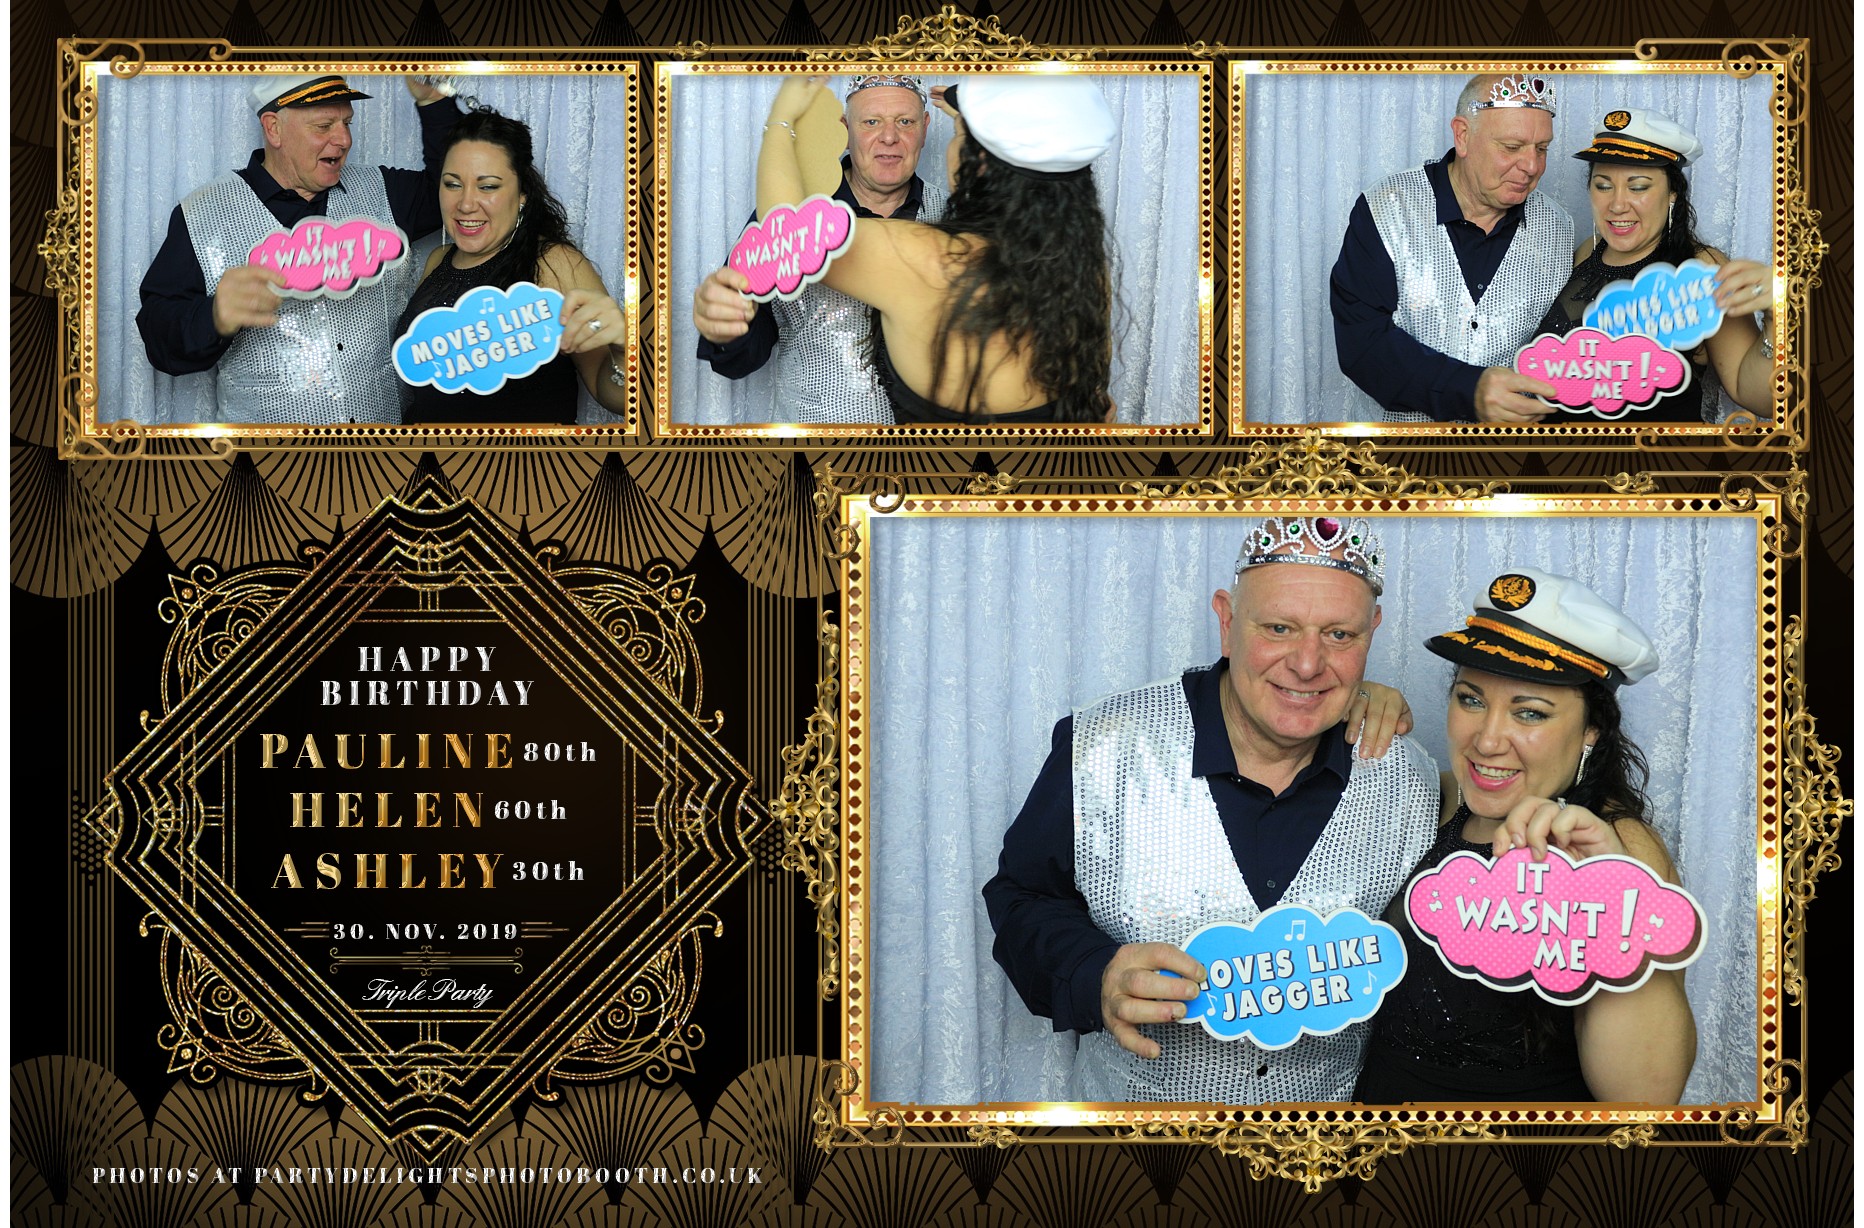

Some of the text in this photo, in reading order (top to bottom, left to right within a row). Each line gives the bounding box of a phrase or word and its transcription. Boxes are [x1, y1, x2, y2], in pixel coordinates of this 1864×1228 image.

[305, 225, 325, 246] IT
[770, 214, 785, 238] IT
[274, 238, 356, 270] WASN'T
[745, 226, 809, 270] WASN'T
[322, 259, 352, 283] ME
[777, 253, 800, 280] ME
[1598, 275, 1715, 331] MOVES LIKE
[411, 299, 552, 365] MOVES LIKE
[1579, 339, 1599, 357] IT
[445, 331, 536, 379] JAGGER
[1544, 359, 1633, 381] WASN'T
[1591, 380, 1623, 400] ME
[1516, 861, 1550, 894] IT
[1454, 895, 1606, 939] WASN'T
[1200, 935, 1381, 991] OVES LIKE
[1532, 938, 1587, 972] ME
[1222, 974, 1351, 1022] JAGGER
